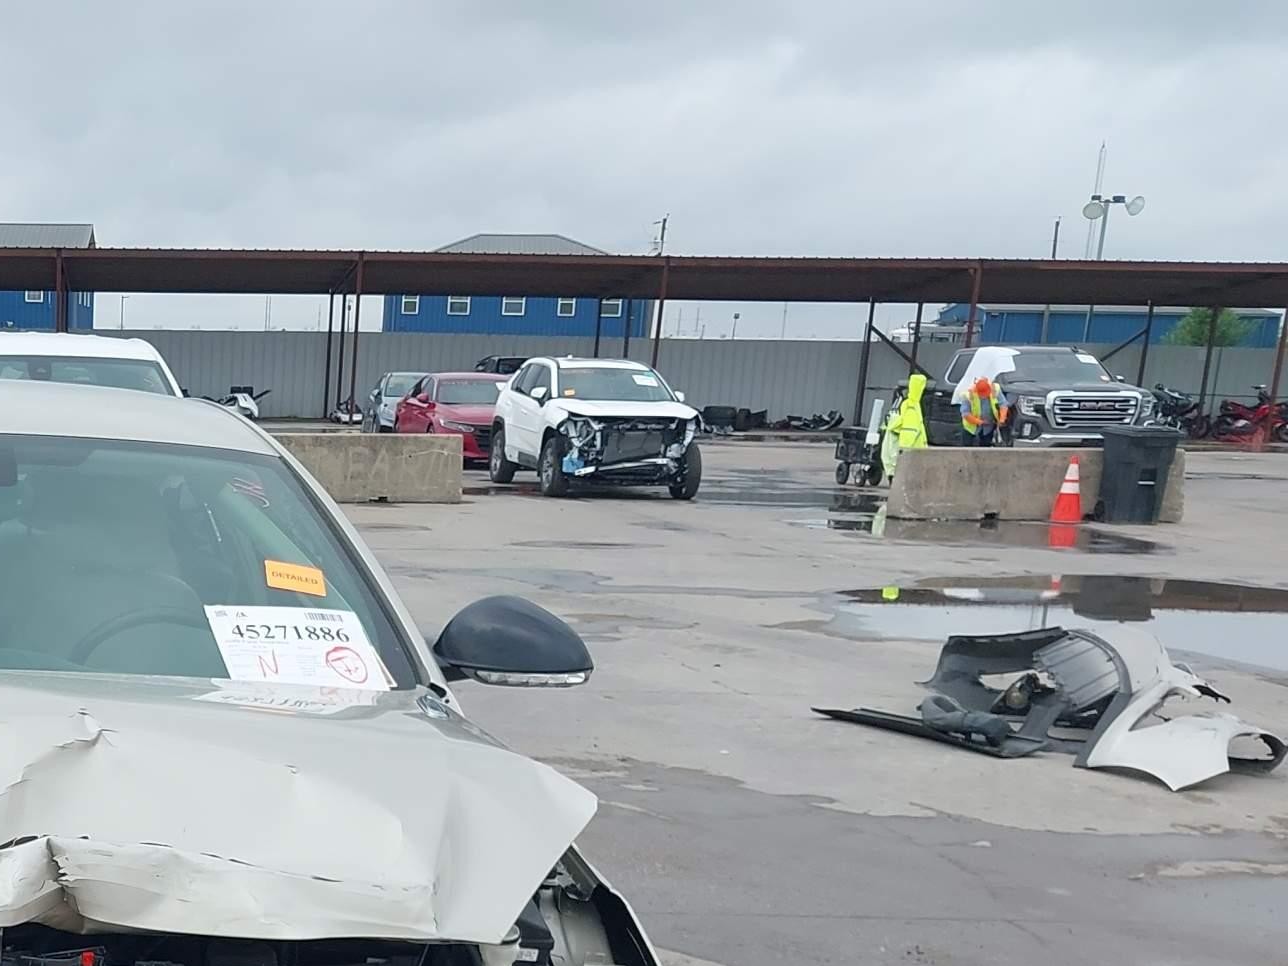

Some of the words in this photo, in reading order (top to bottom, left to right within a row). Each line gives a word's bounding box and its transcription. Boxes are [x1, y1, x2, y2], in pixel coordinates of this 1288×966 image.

[271, 571, 319, 585] DETAILED
[232, 624, 350, 643] 45271886
[259, 649, 278, 677] N
